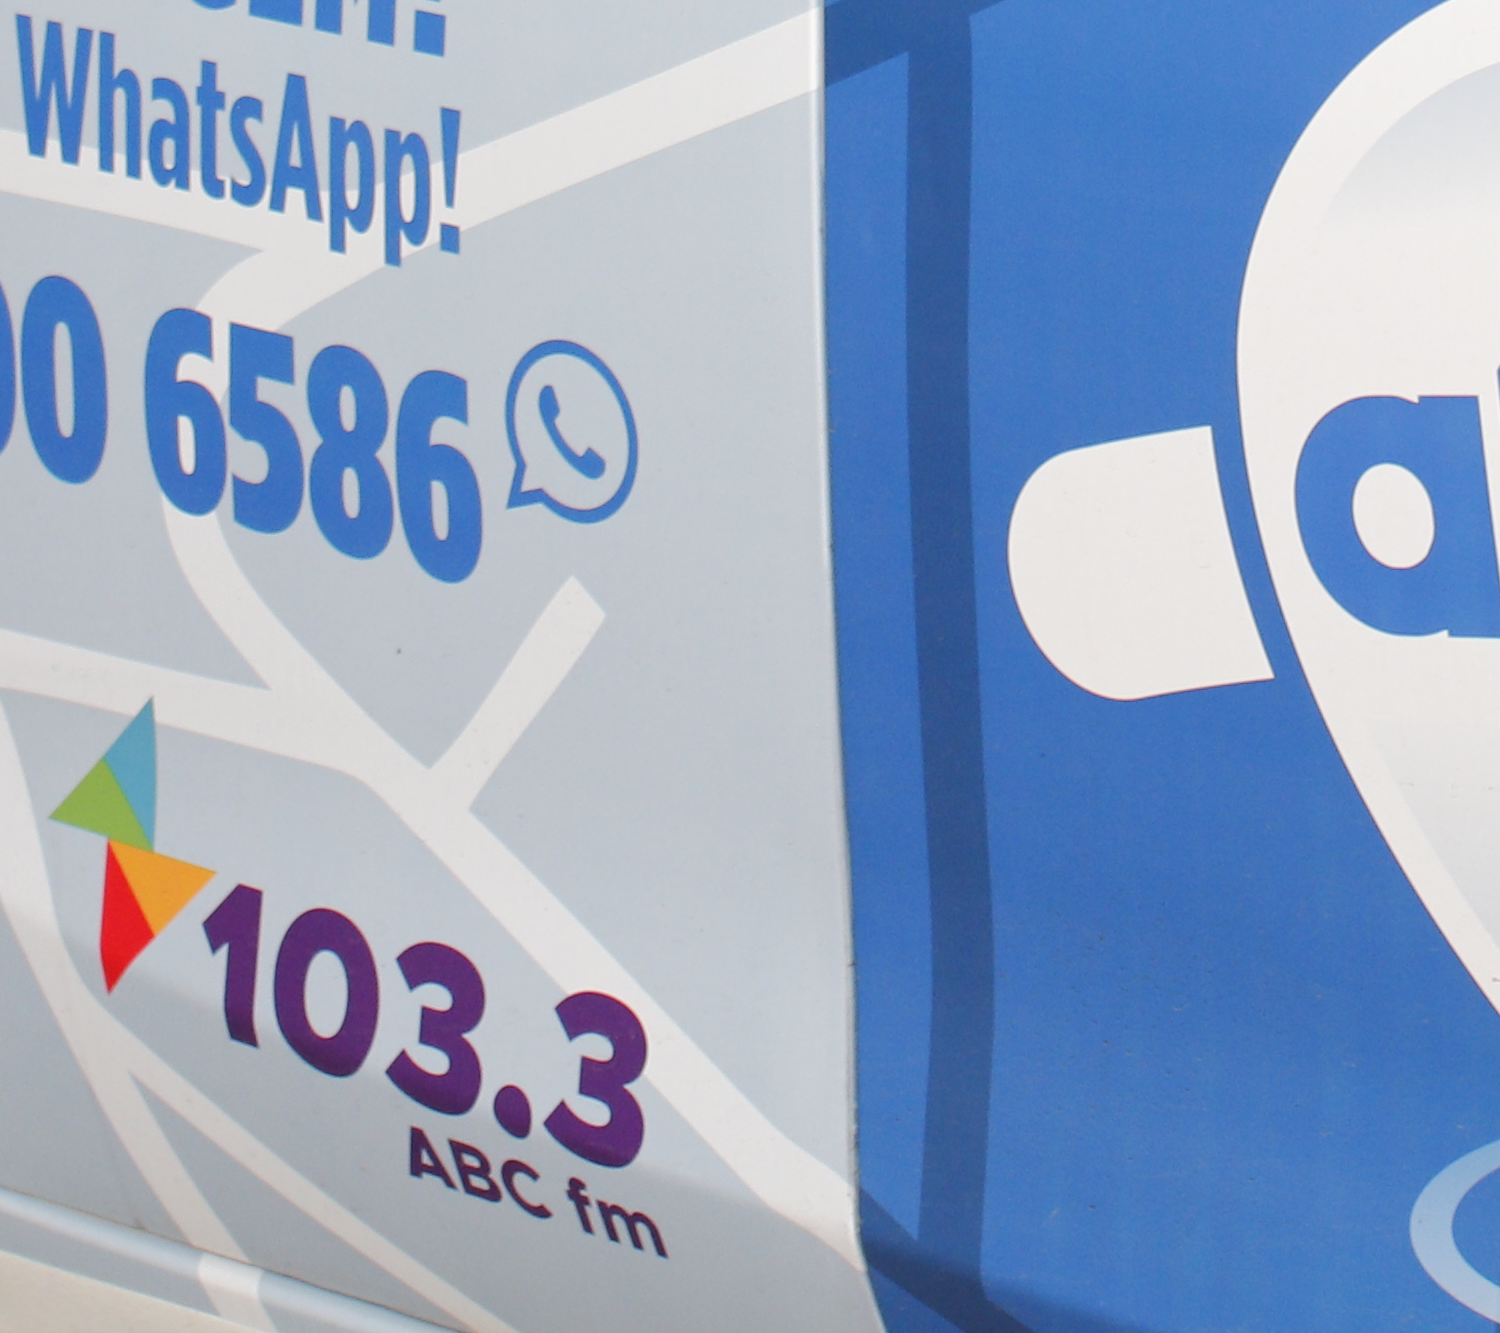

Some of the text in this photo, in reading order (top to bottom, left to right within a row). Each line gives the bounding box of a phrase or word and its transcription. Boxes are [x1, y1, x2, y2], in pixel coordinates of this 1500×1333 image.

[15, 14, 461, 267] WhatsApp!
[144, 308, 482, 584] 6586
[203, 884, 647, 1169] 103.3
[408, 1127, 670, 1259] ABC fm
